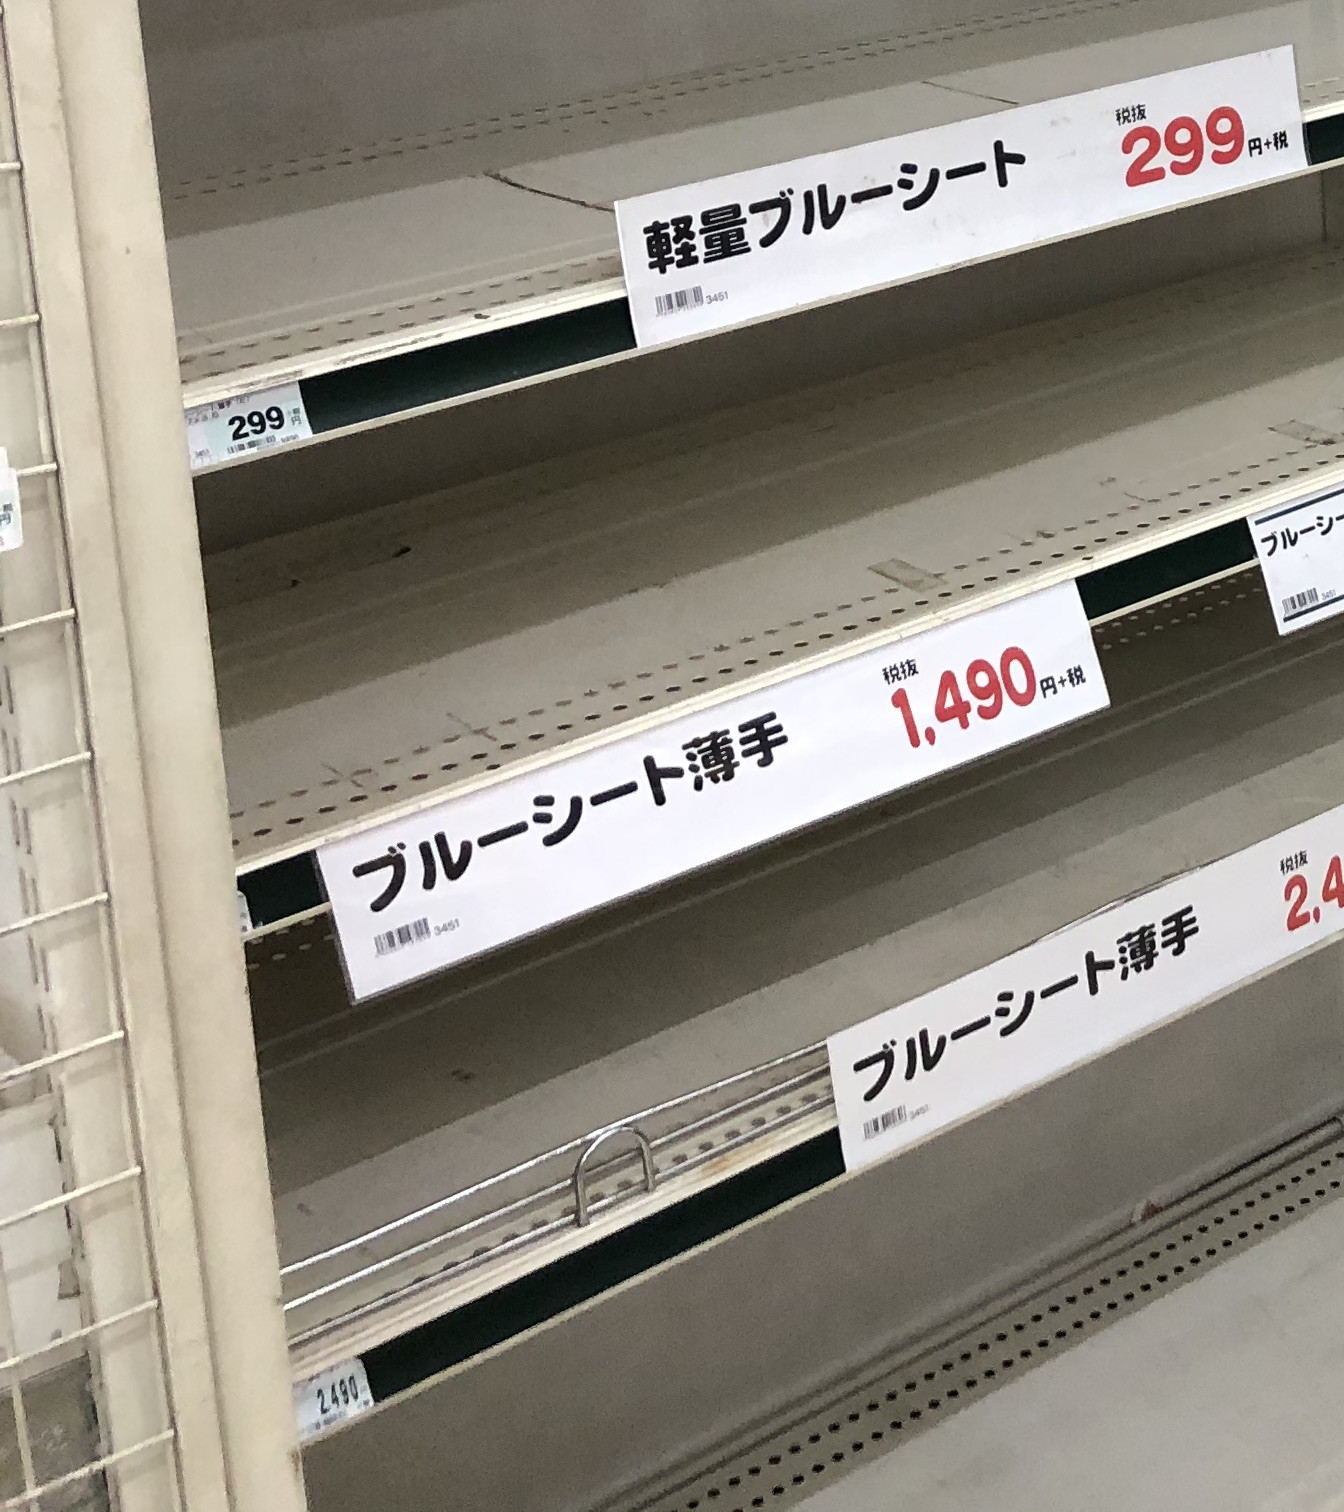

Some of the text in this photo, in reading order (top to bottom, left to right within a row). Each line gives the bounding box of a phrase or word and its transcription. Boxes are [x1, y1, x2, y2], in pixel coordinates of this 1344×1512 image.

[1114, 103, 1148, 126] 税抜
[1120, 105, 1290, 188] 299 円+税
[643, 139, 1027, 275] 軽量ブルーシート
[227, 405, 286, 442] 299
[880, 657, 921, 685] 税抜
[890, 645, 1088, 750] 1,490 円+税
[352, 710, 790, 912] ブルーシート薄手
[1278, 849, 1310, 876] 税抜
[852, 904, 1200, 1102] ブルーシート薄手
